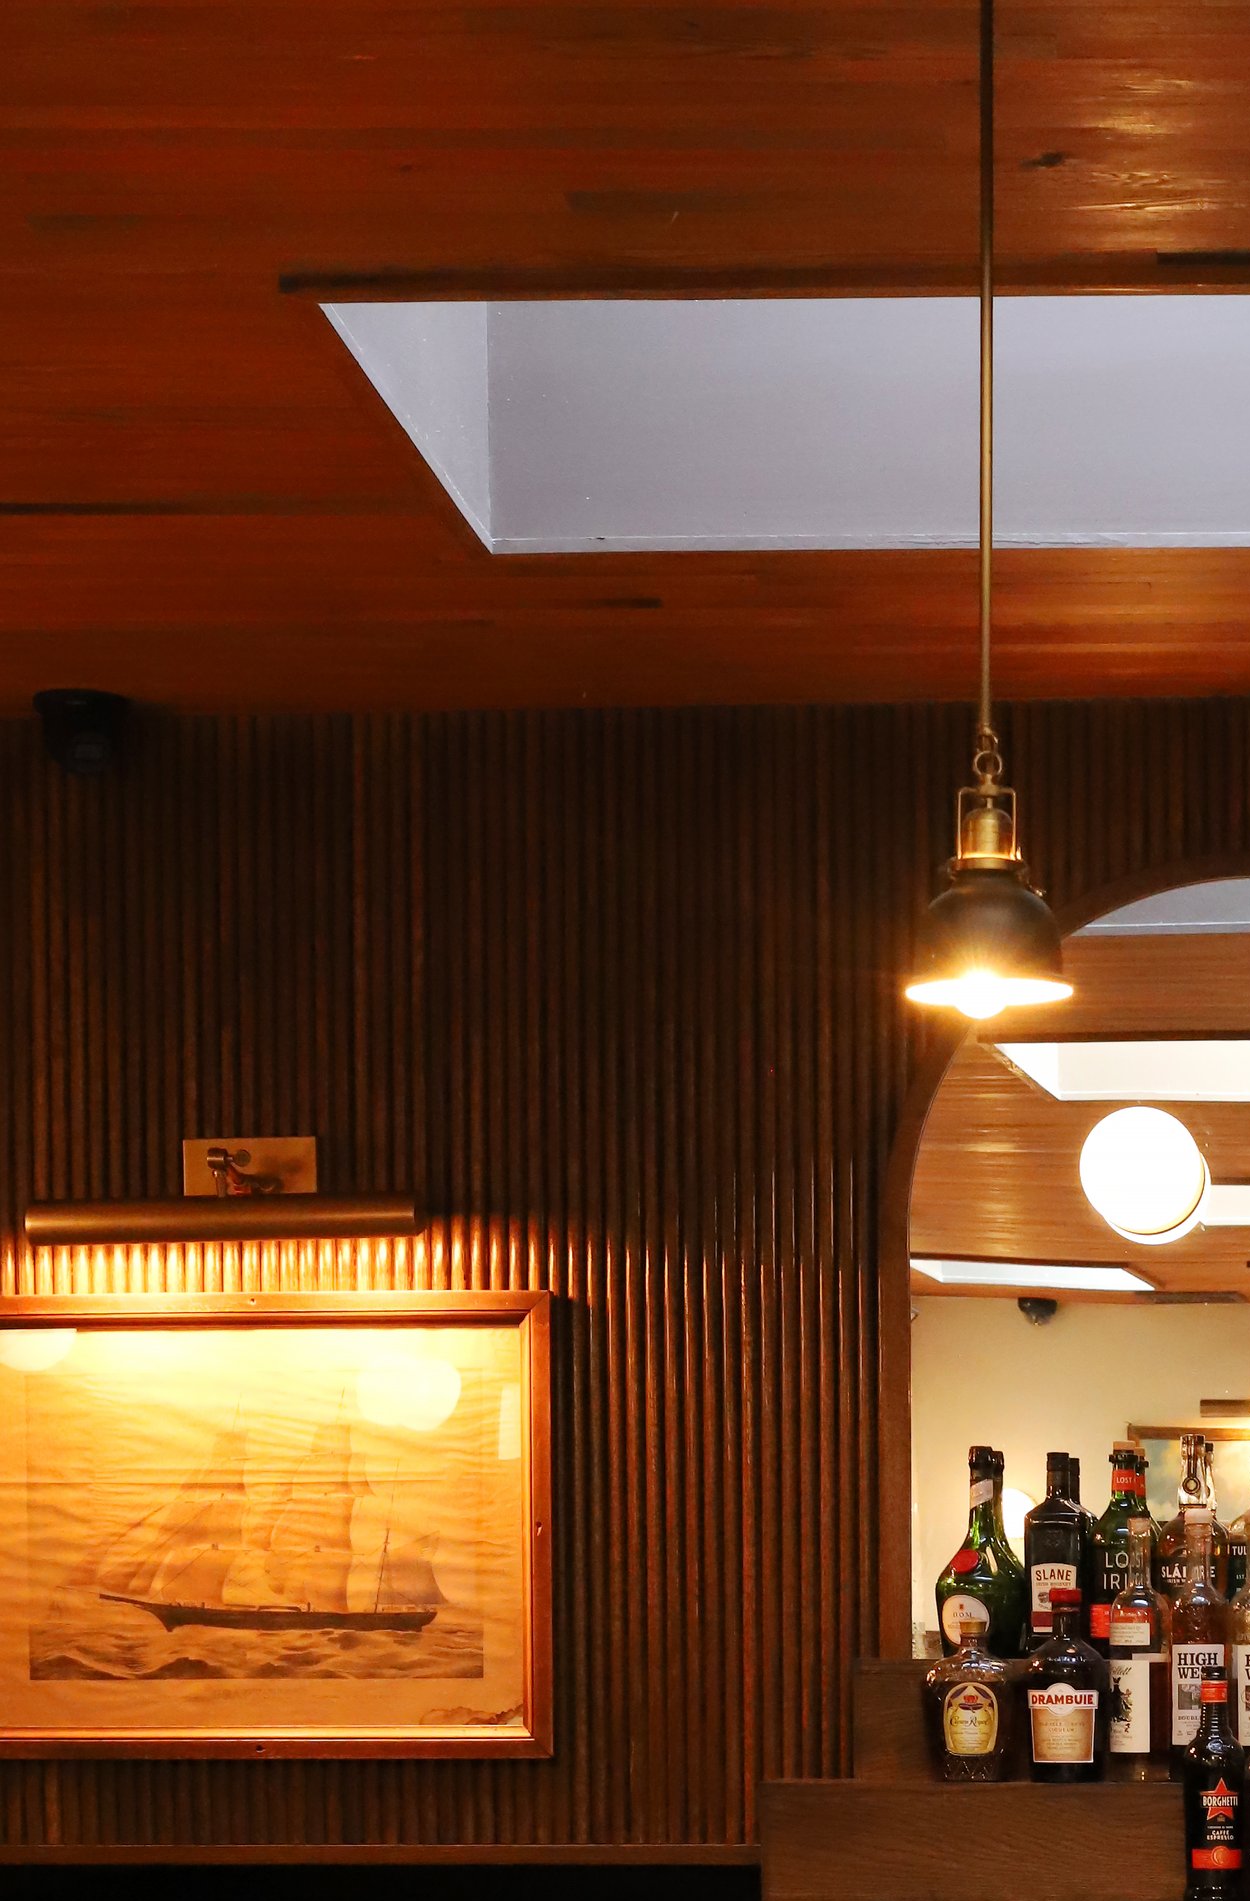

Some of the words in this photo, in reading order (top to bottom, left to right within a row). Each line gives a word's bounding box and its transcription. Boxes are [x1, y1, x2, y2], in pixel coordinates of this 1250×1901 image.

[1035, 1568, 1072, 1581] SLANE
[1177, 1652, 1218, 1666] HIGH
[1178, 1666, 1200, 1679] WE
[1031, 1694, 1094, 1705] DRAMBUIE
[1202, 1795, 1239, 1807] BORGHETTI
